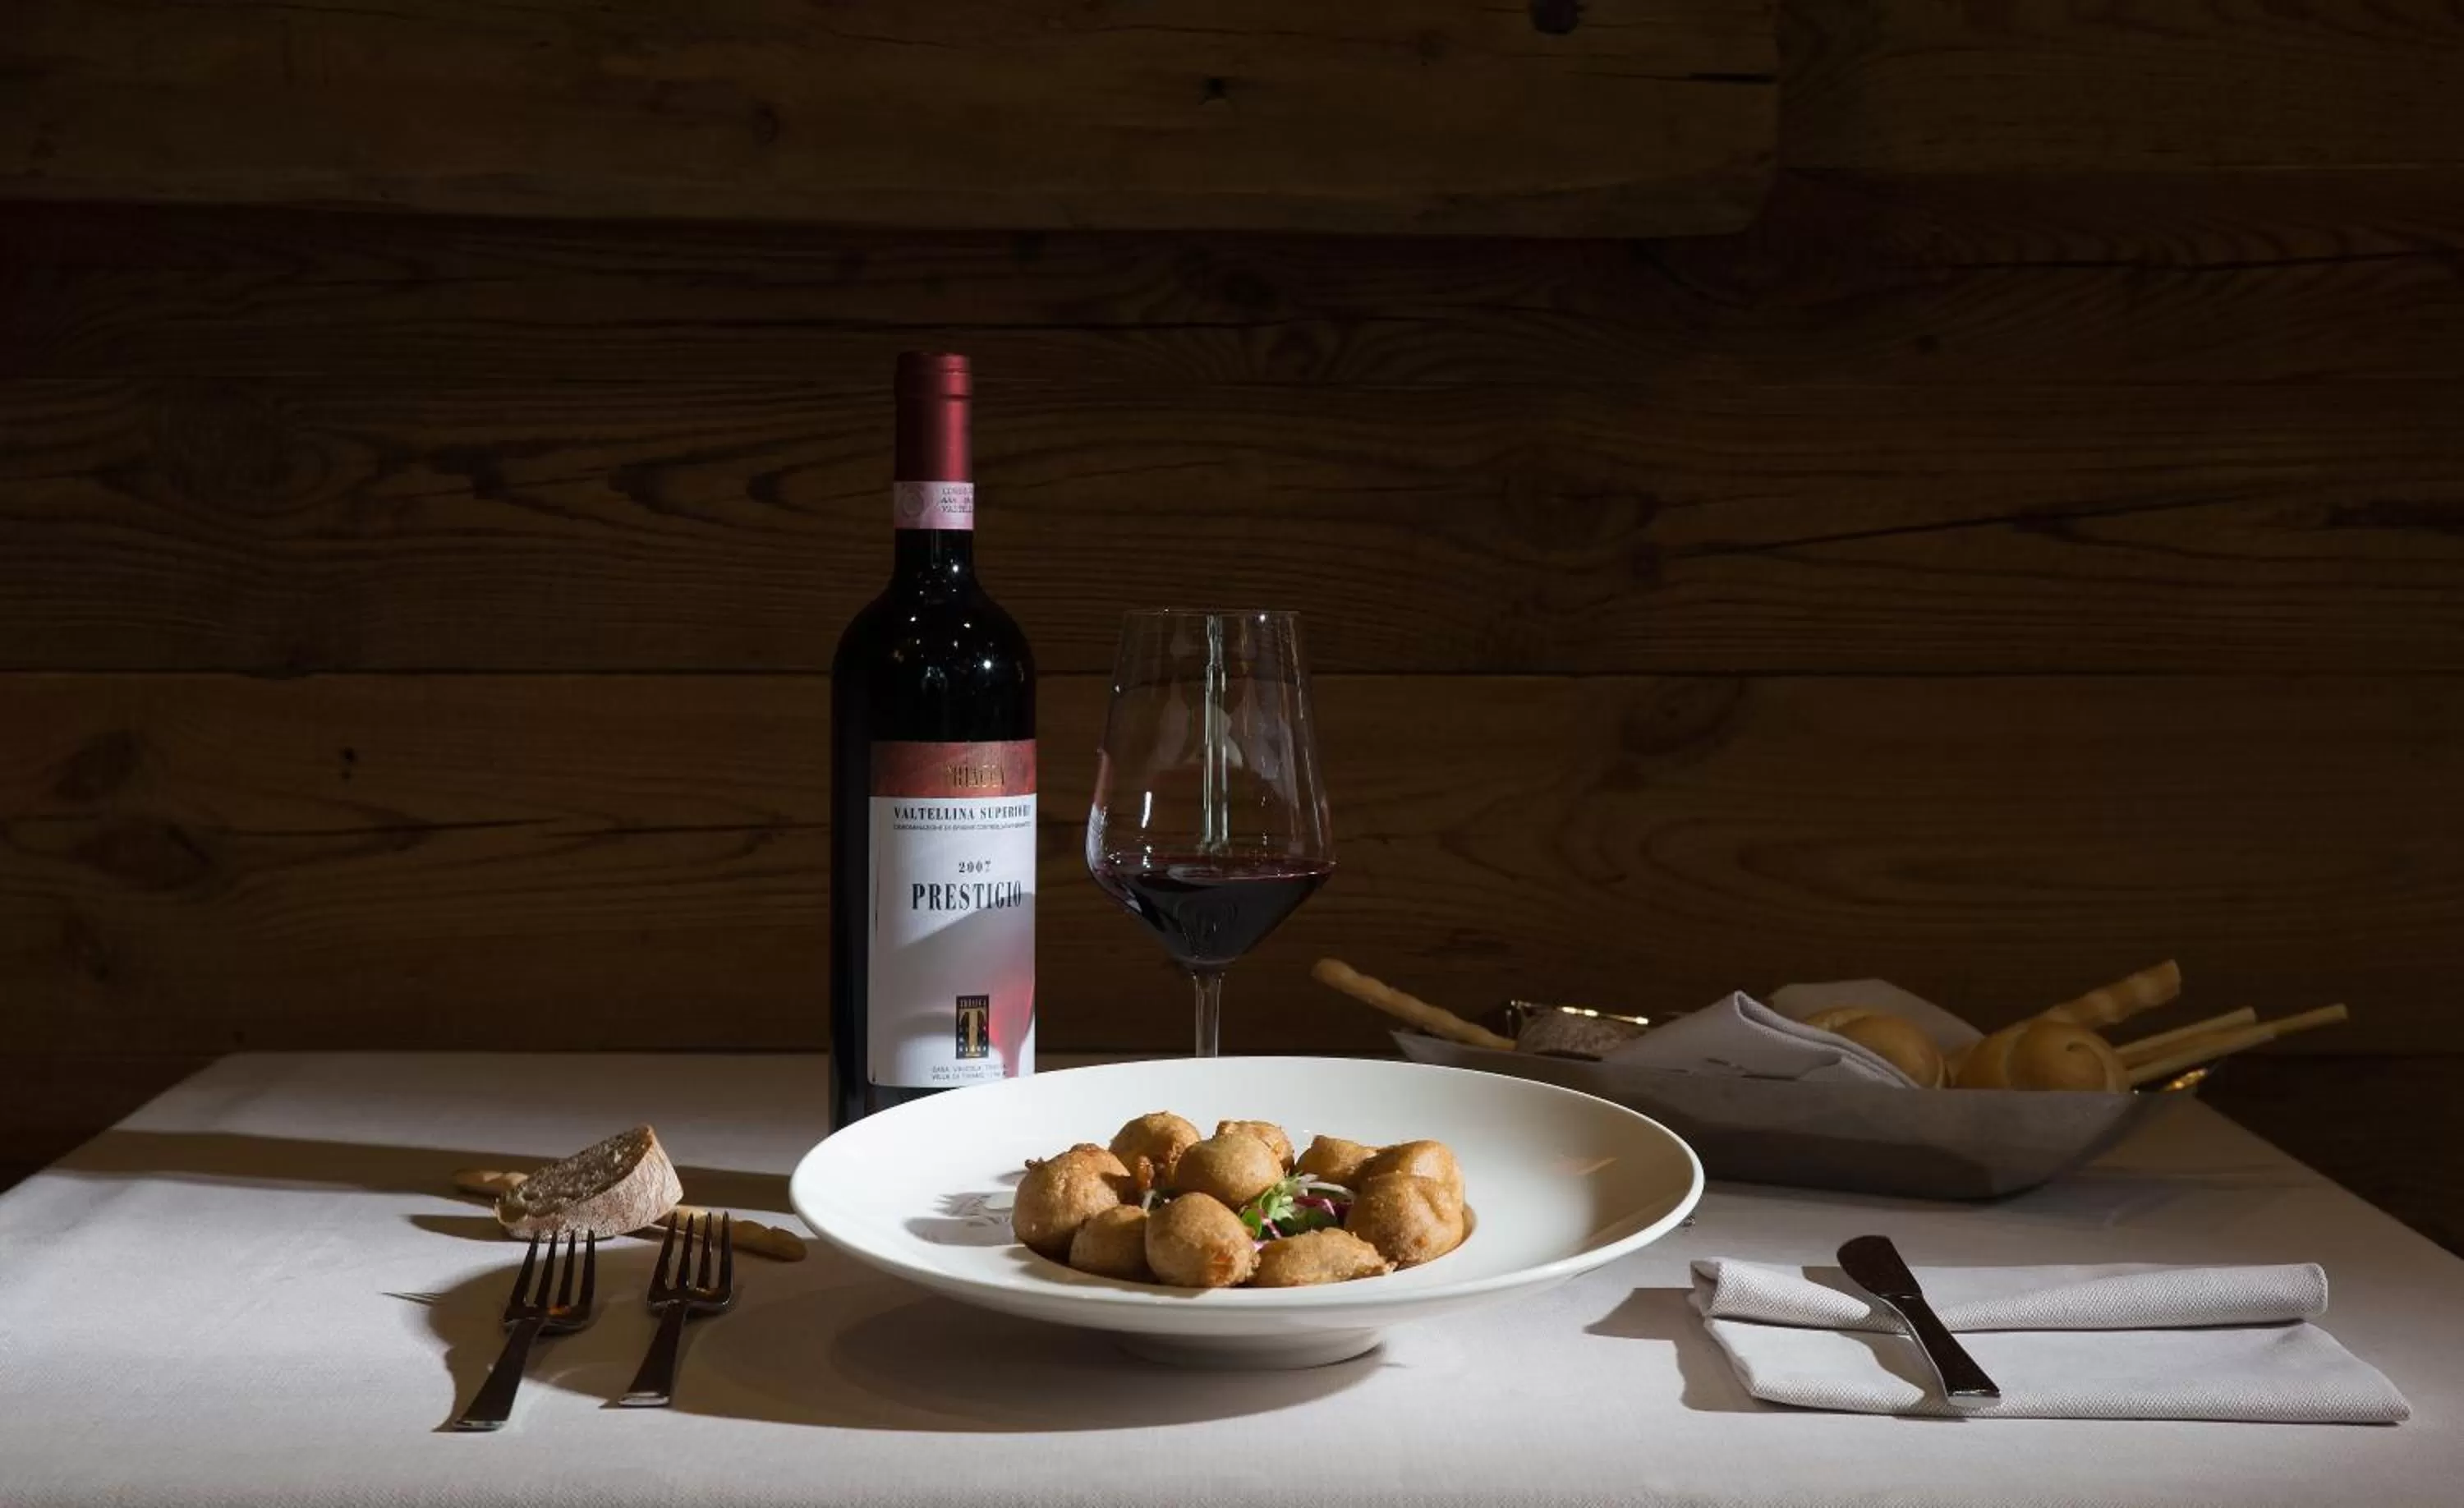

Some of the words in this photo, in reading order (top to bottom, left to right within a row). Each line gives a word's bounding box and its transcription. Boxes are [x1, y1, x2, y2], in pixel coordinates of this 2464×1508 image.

[894, 807, 975, 821] VALTELLINA
[958, 861, 991, 873] 2007
[912, 880, 1021, 910] PRESTIGIO
